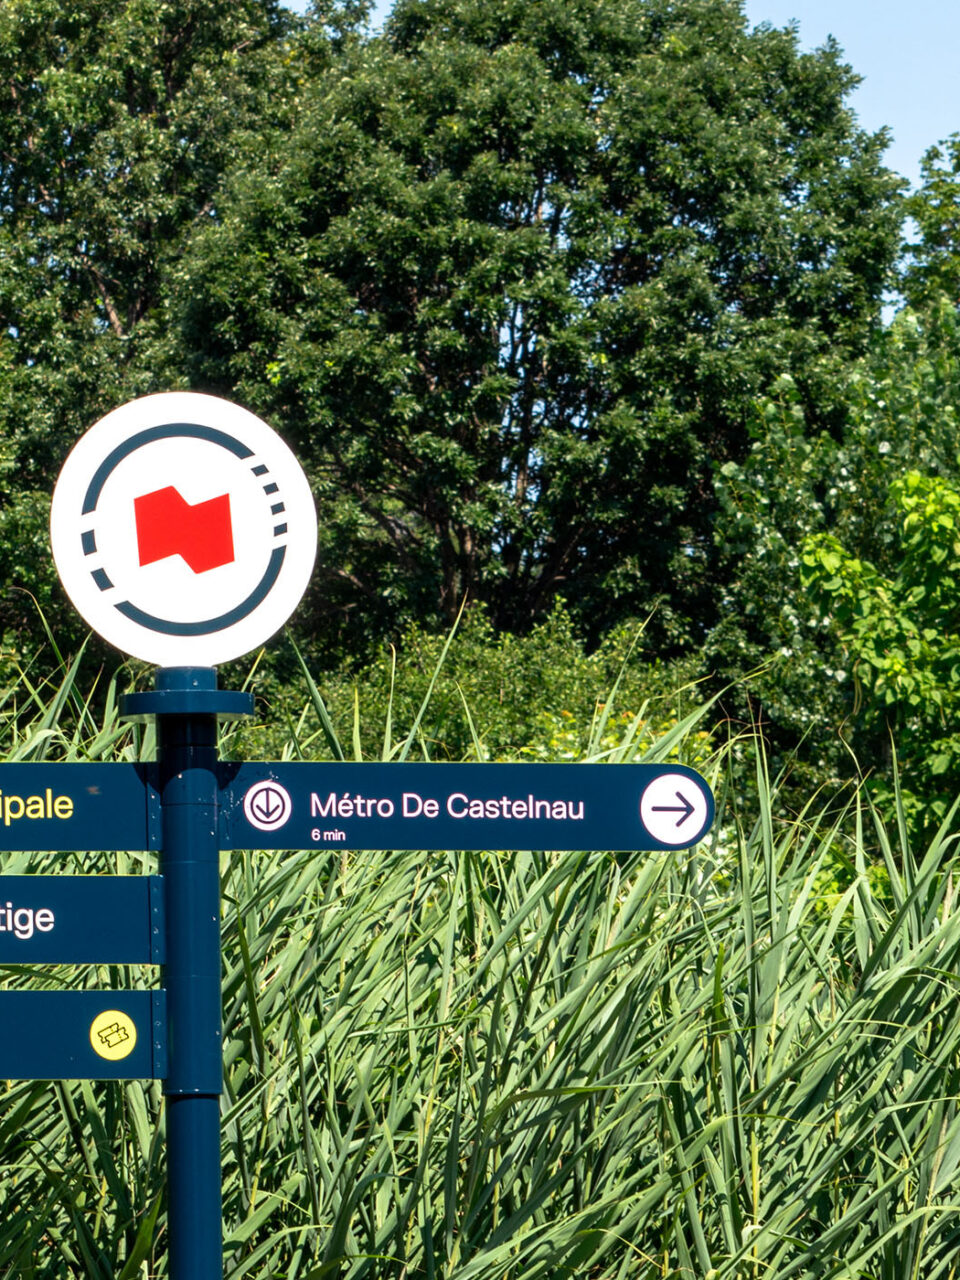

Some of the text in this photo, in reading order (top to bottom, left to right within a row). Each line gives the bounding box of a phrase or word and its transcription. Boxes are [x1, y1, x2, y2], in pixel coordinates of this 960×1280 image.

[310, 792, 585, 820] Métro De Castelnau
[311, 828, 346, 841] 6 min
